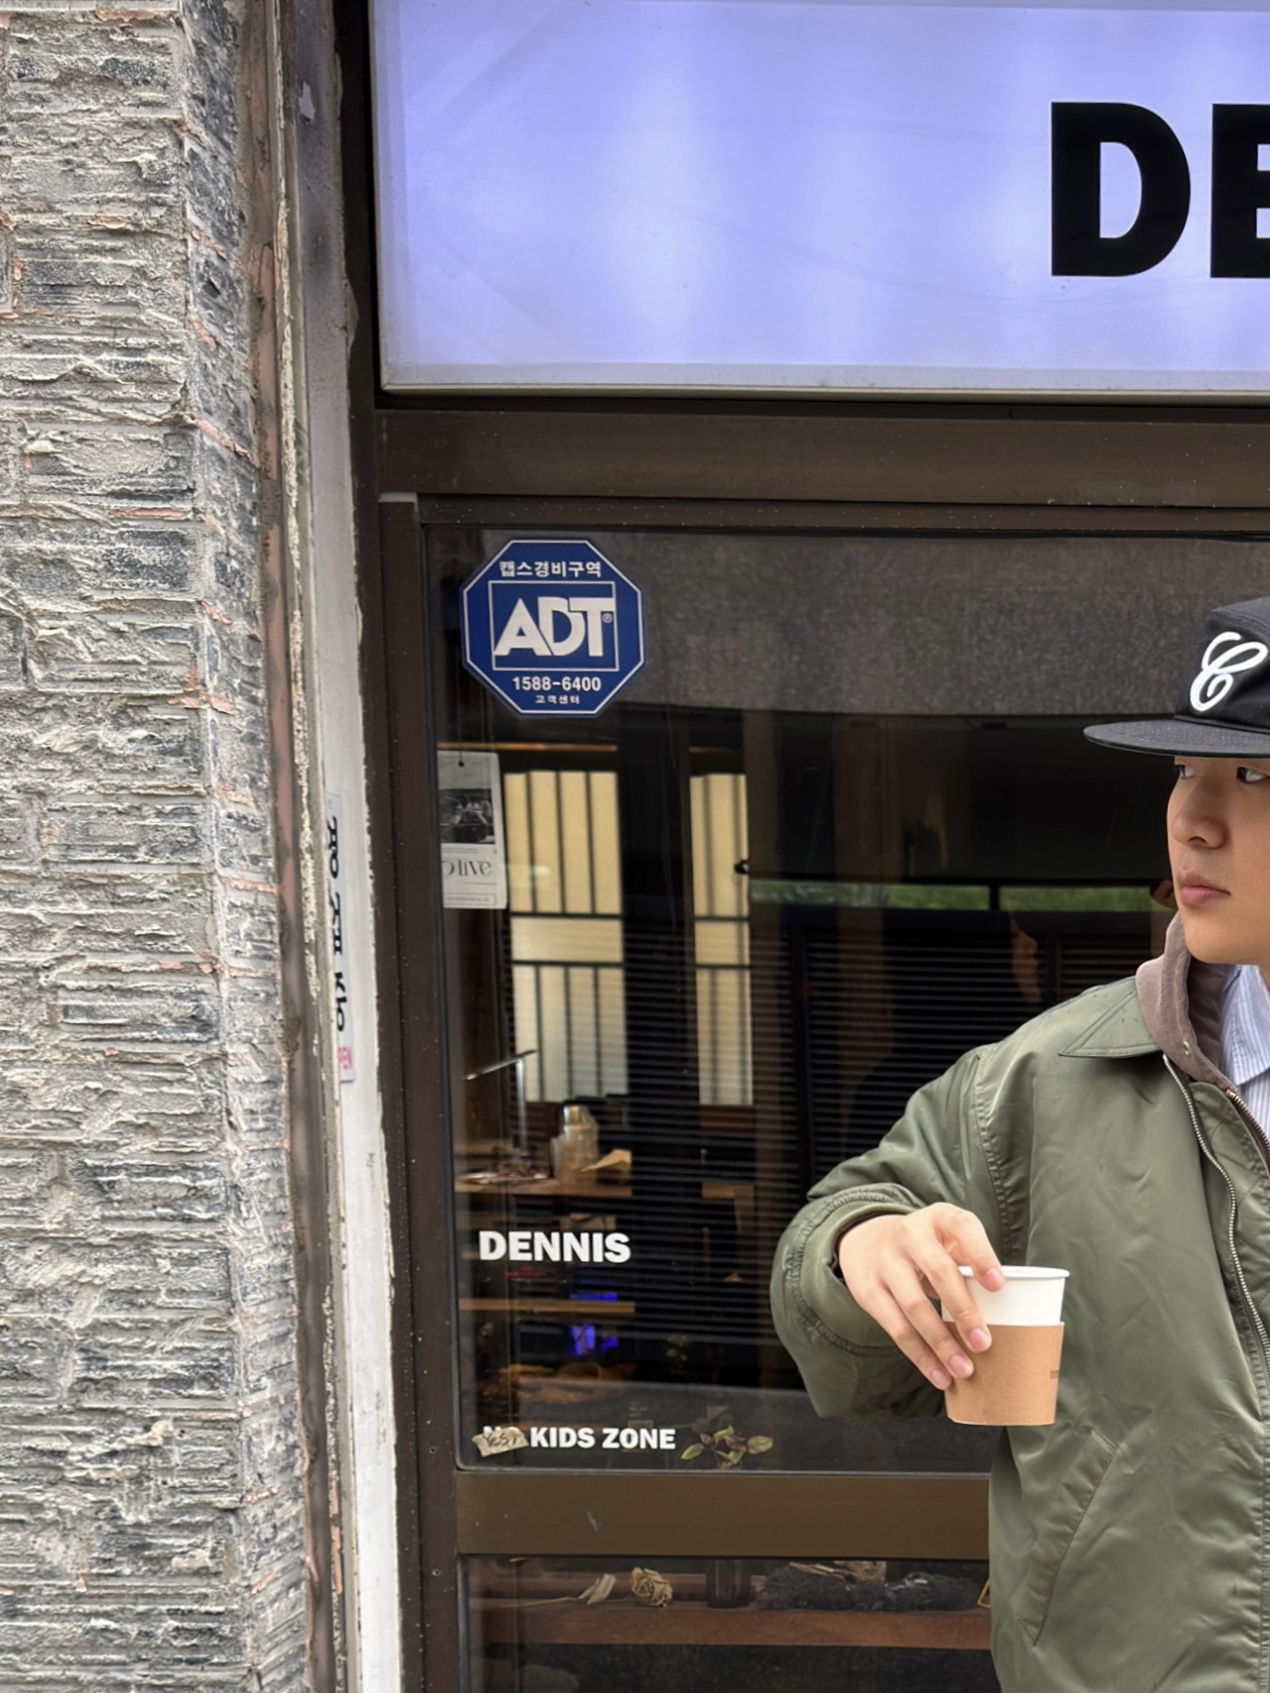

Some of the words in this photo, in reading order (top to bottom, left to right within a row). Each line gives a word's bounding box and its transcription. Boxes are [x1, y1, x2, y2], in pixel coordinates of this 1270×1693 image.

[500, 561, 601, 578] 캡스경비구역
[493, 596, 616, 657] ADT
[513, 676, 601, 691] 1588-6400
[535, 695, 581, 705] 고객센터
[479, 1231, 632, 1263] DENNIS
[530, 1426, 596, 1448] KIDS
[602, 1428, 676, 1450] ZONE
